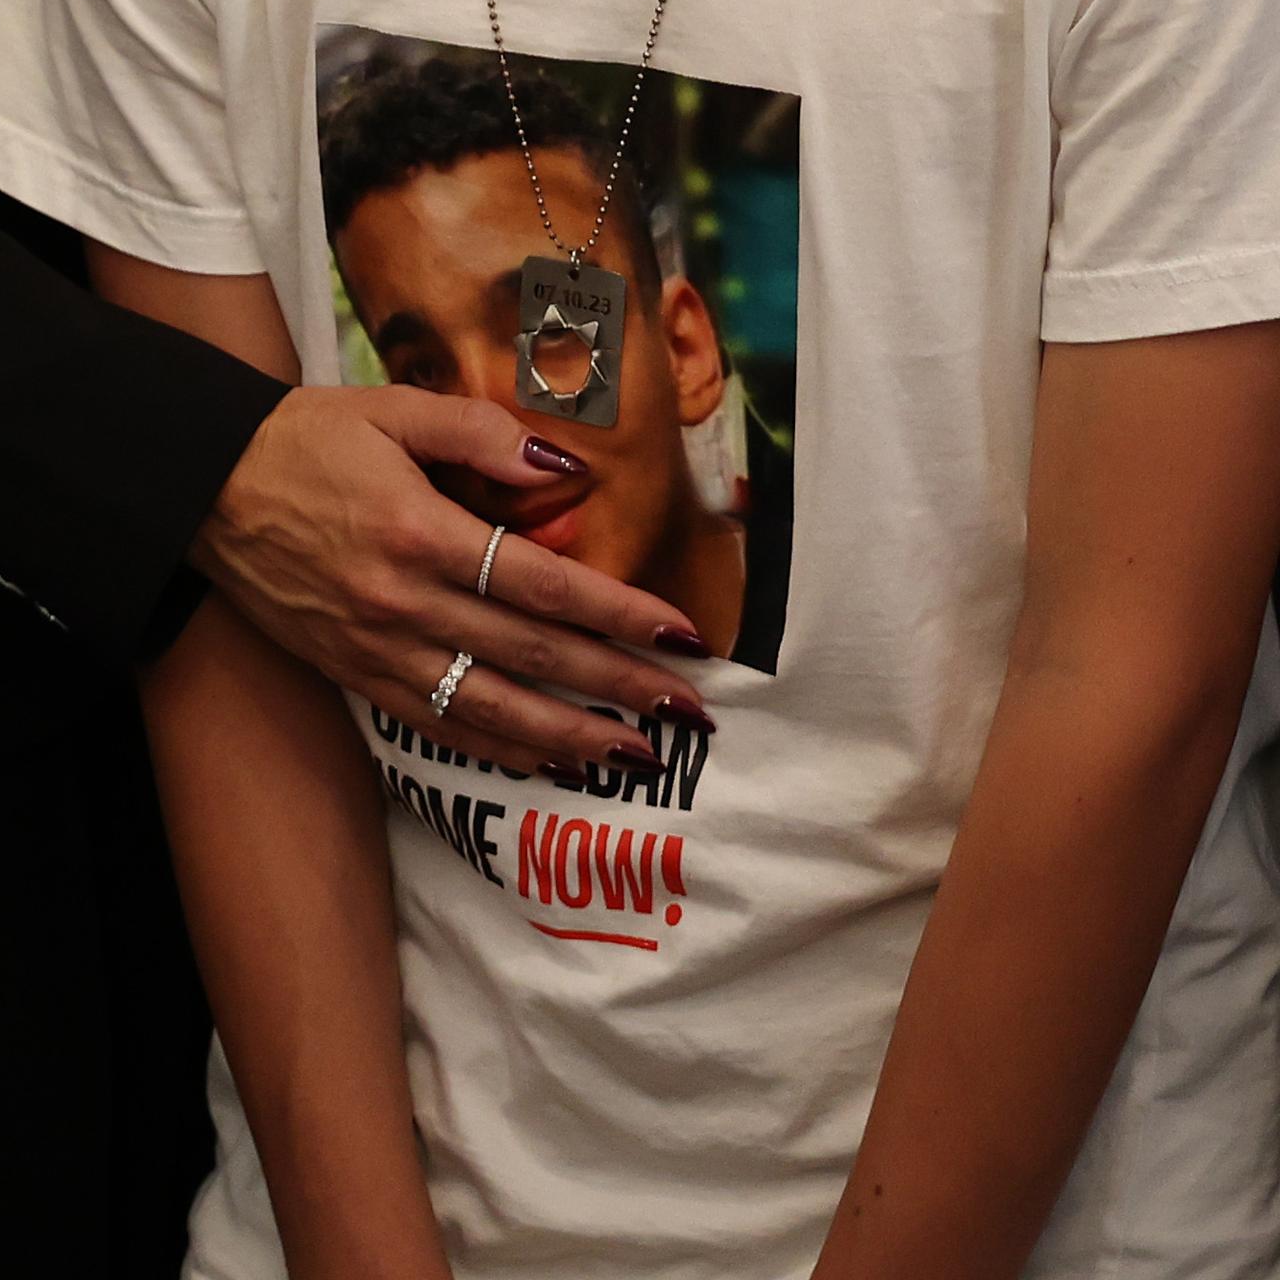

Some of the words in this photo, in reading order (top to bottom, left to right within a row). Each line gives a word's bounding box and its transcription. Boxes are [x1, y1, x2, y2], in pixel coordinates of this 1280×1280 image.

[533, 282, 611, 315] 07.10.23
[554, 706, 709, 812] DAN
[516, 808, 688, 928] NOW!
